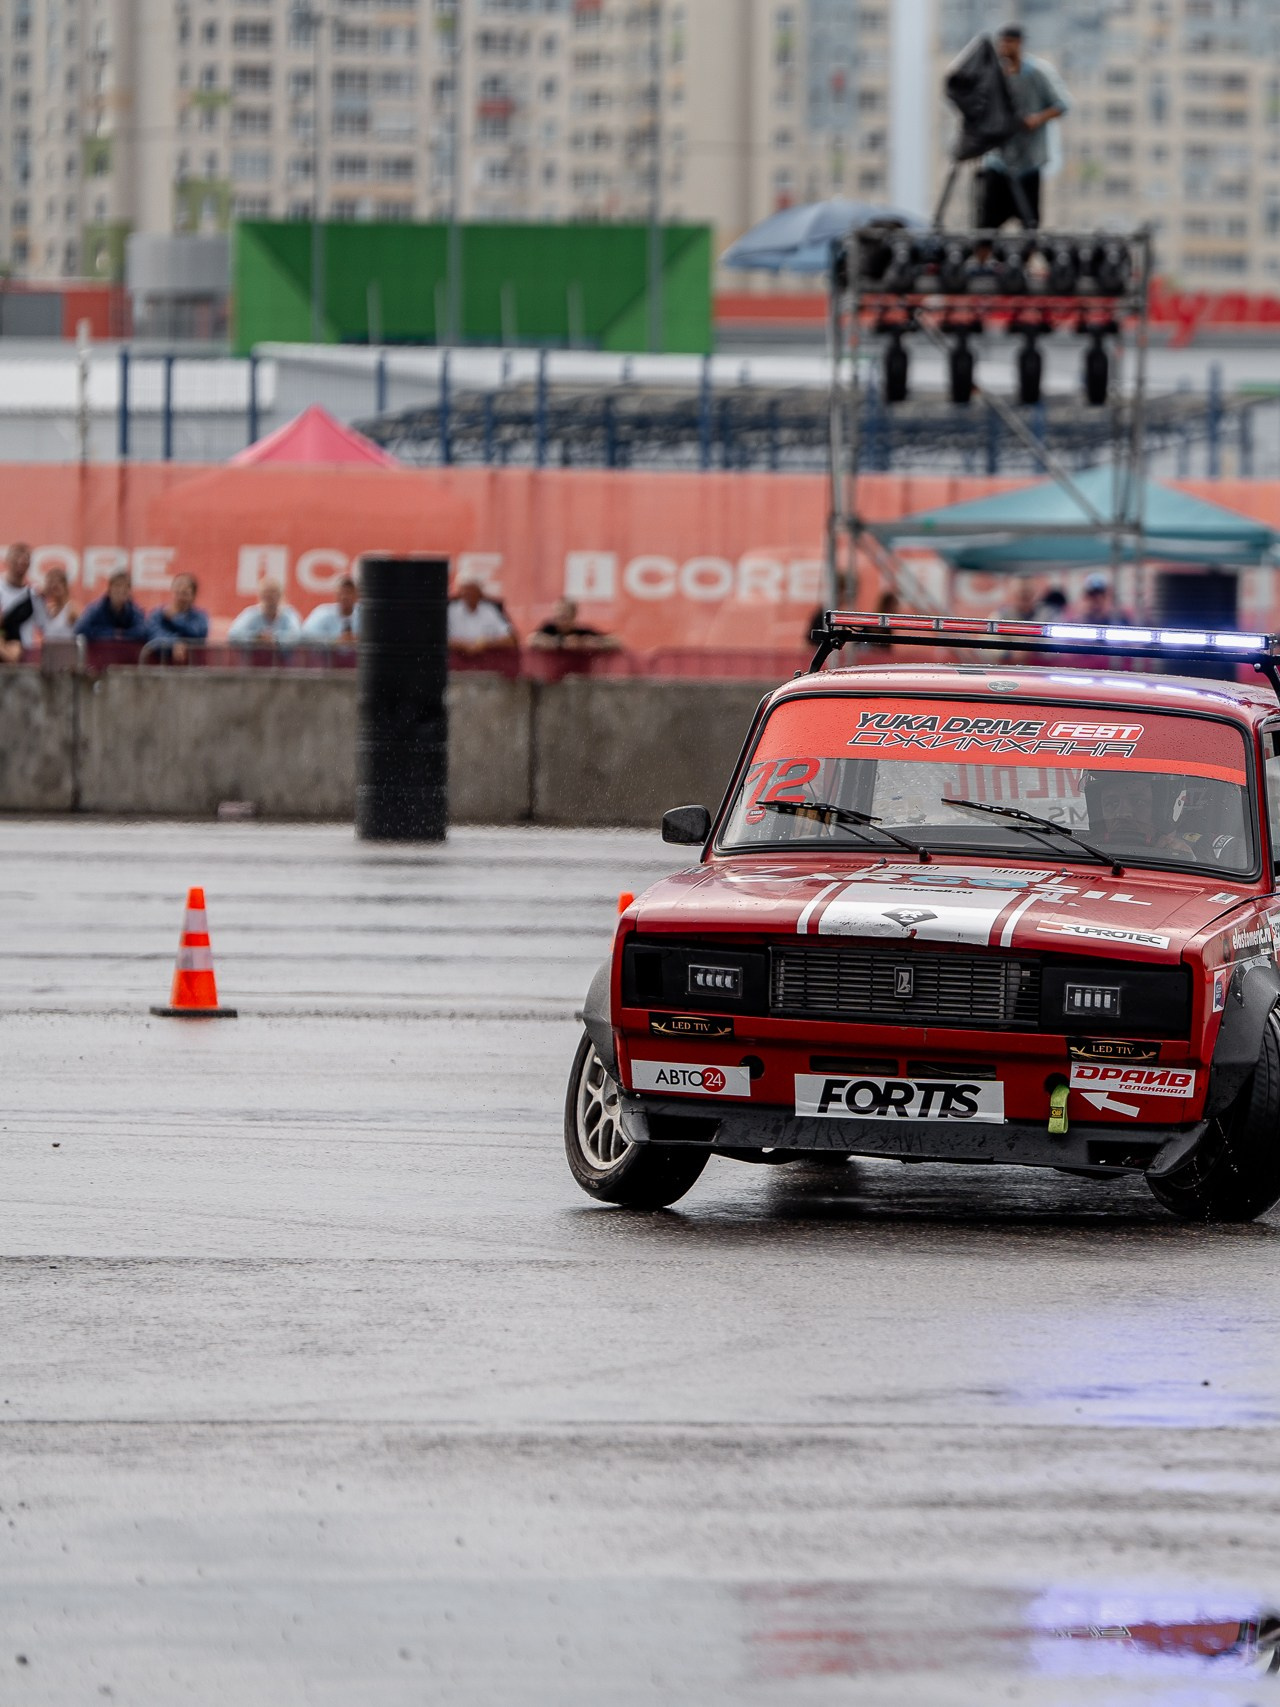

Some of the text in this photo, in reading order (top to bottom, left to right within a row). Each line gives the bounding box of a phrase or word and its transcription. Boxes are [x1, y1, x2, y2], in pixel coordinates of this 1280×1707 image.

[624, 554, 834, 602] CORE
[856, 711, 1140, 739] YUKA DRIVE FEST
[847, 731, 1138, 758] ДЖИМХАНА
[746, 758, 820, 809] 12
[1062, 924, 1164, 945] SUPROTEC
[672, 1021, 711, 1032] LED TIV
[1092, 1045, 1135, 1055] LED TIV
[817, 1079, 982, 1119] FORTIS
